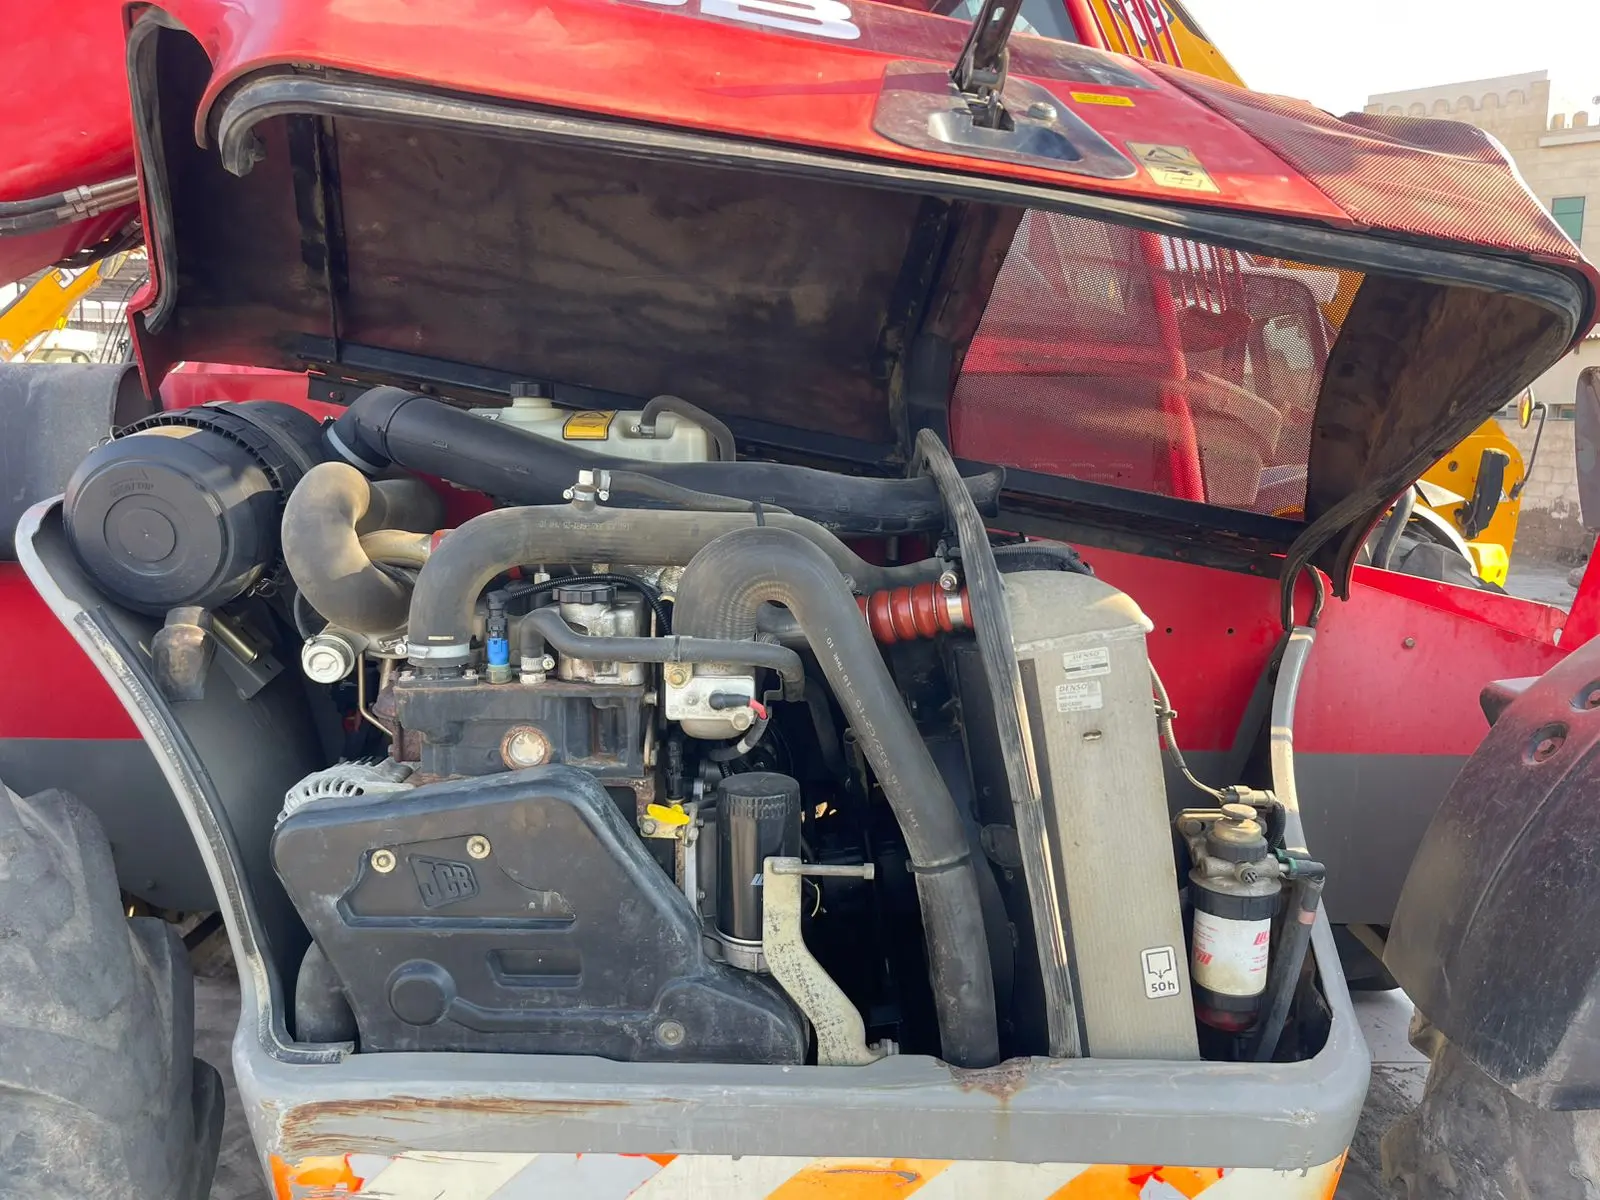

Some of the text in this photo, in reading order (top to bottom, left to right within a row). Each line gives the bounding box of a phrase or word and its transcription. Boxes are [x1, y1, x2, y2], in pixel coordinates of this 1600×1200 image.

[1072, 650, 1100, 660] DENSO
[1059, 682, 1088, 693] DENSO
[417, 858, 475, 907] JCB
